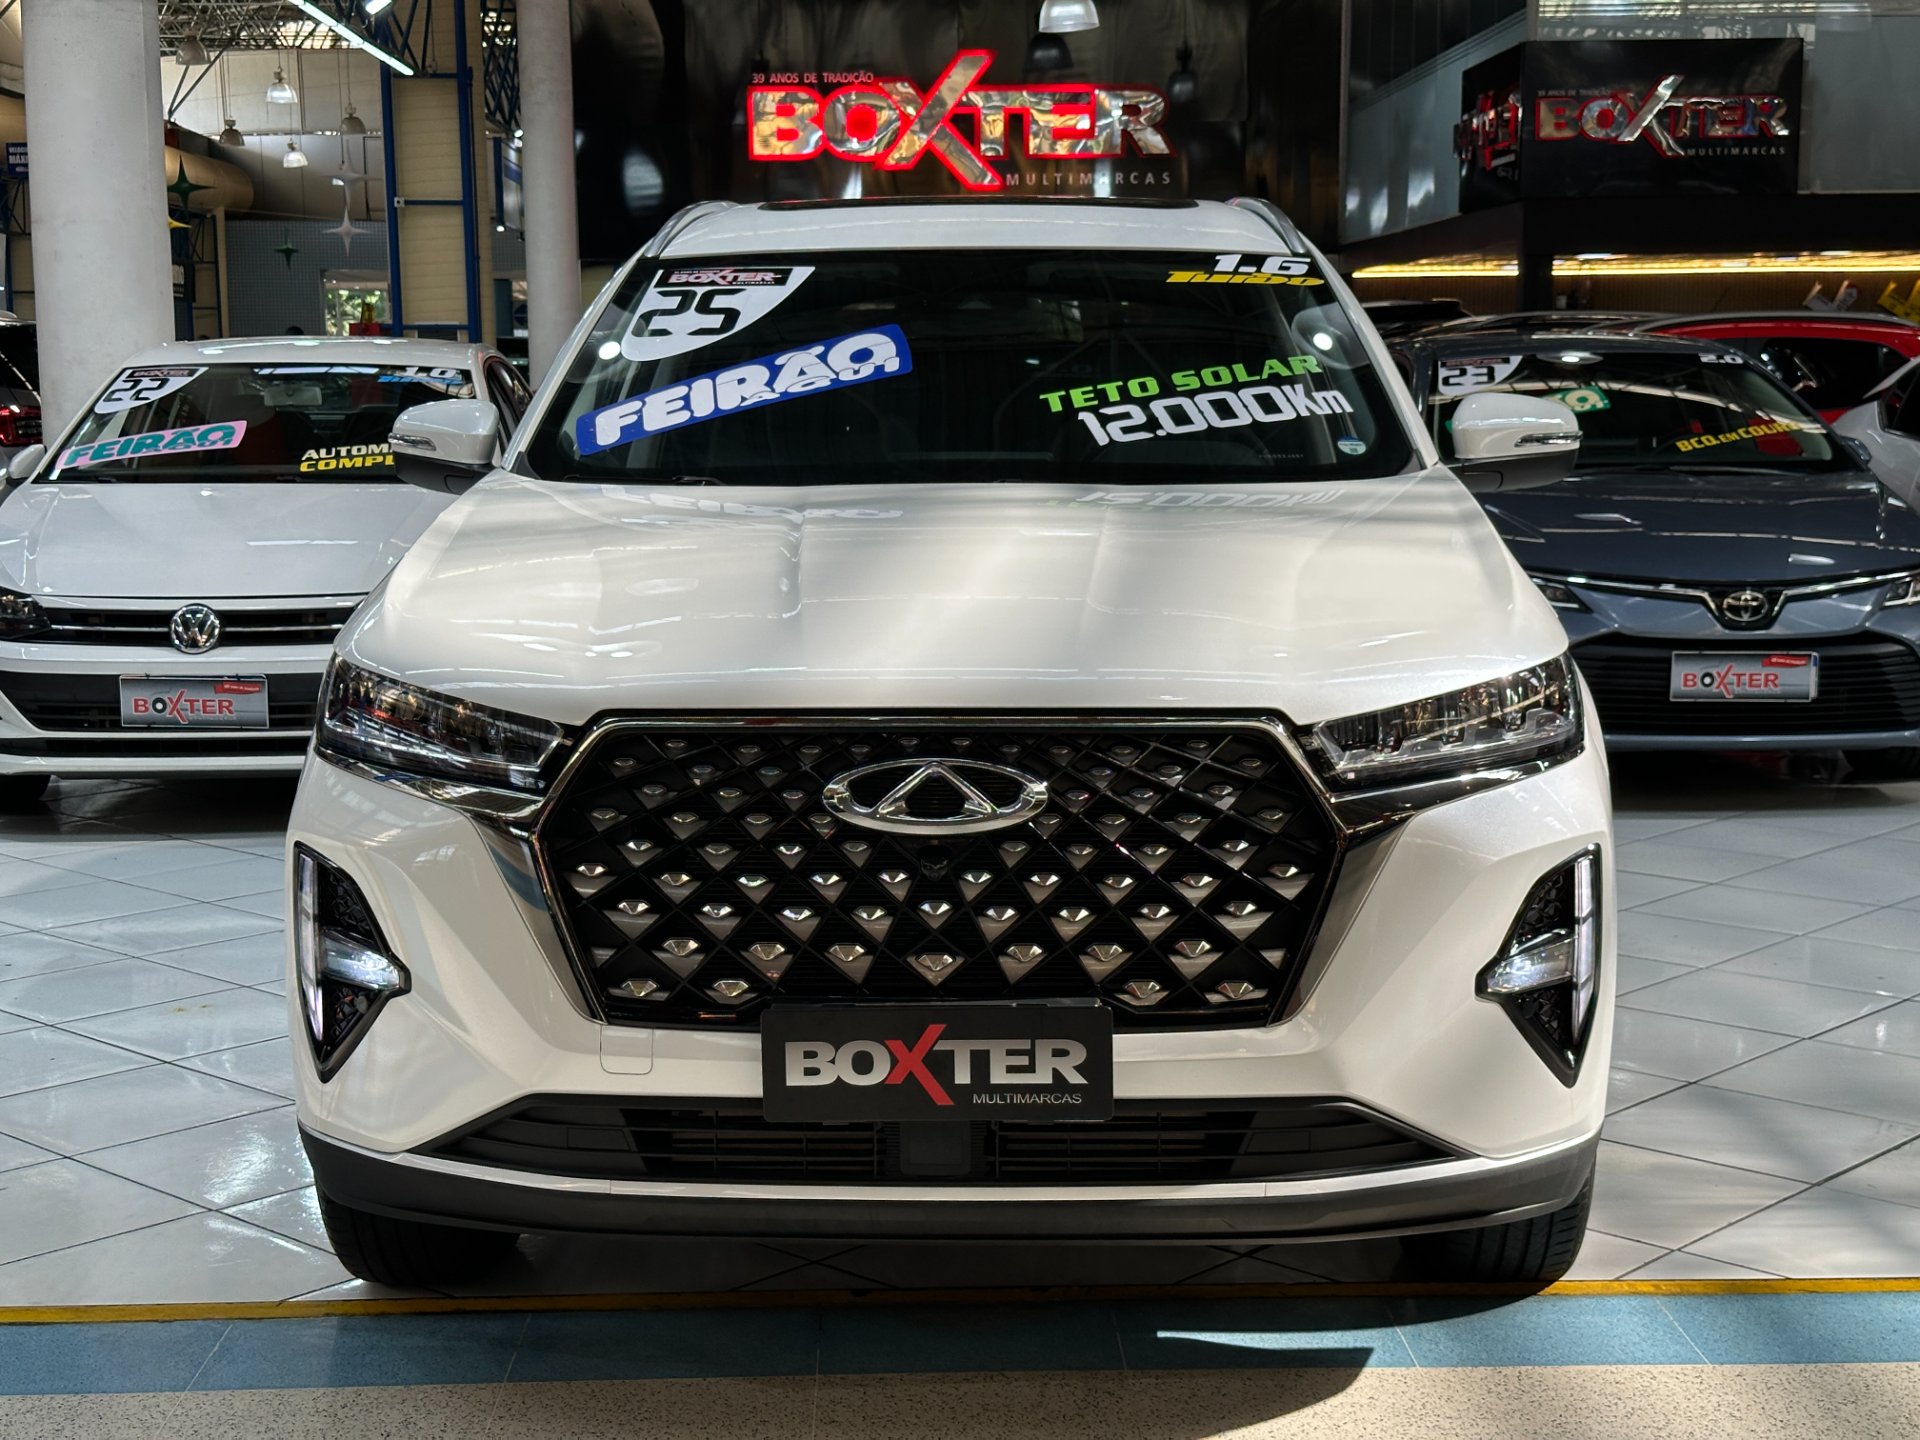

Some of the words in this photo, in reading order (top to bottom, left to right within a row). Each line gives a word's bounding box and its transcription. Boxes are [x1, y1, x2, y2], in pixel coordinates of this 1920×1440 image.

[752, 73, 765, 83] 39
[769, 73, 799, 83] ANOS
[803, 73, 818, 83] DE
[822, 70, 874, 84] TRADIÇÃO
[748, 48, 1177, 191] BOXTER
[1535, 74, 1790, 158] BOXTER
[1005, 172, 1171, 186] MULTIMARCAS
[667, 269, 775, 285] BOXTER
[1214, 254, 1312, 275] 1.6
[631, 288, 747, 338] 25
[1699, 353, 1744, 364] 2.0
[102, 378, 170, 402] 22
[595, 333, 897, 445] FEIRÃO
[1040, 376, 1160, 412] TETO
[1171, 354, 1323, 392] SOLAR
[1441, 365, 1496, 386] 23
[64, 424, 236, 466] FEIRÃO
[301, 443, 393, 460] AUTOM
[1681, 663, 1781, 698] BOXTER
[132, 689, 236, 724] BOXTER
[785, 1024, 1089, 1106] BOXTER
[973, 1093, 1082, 1104] MULTIMARCAS
